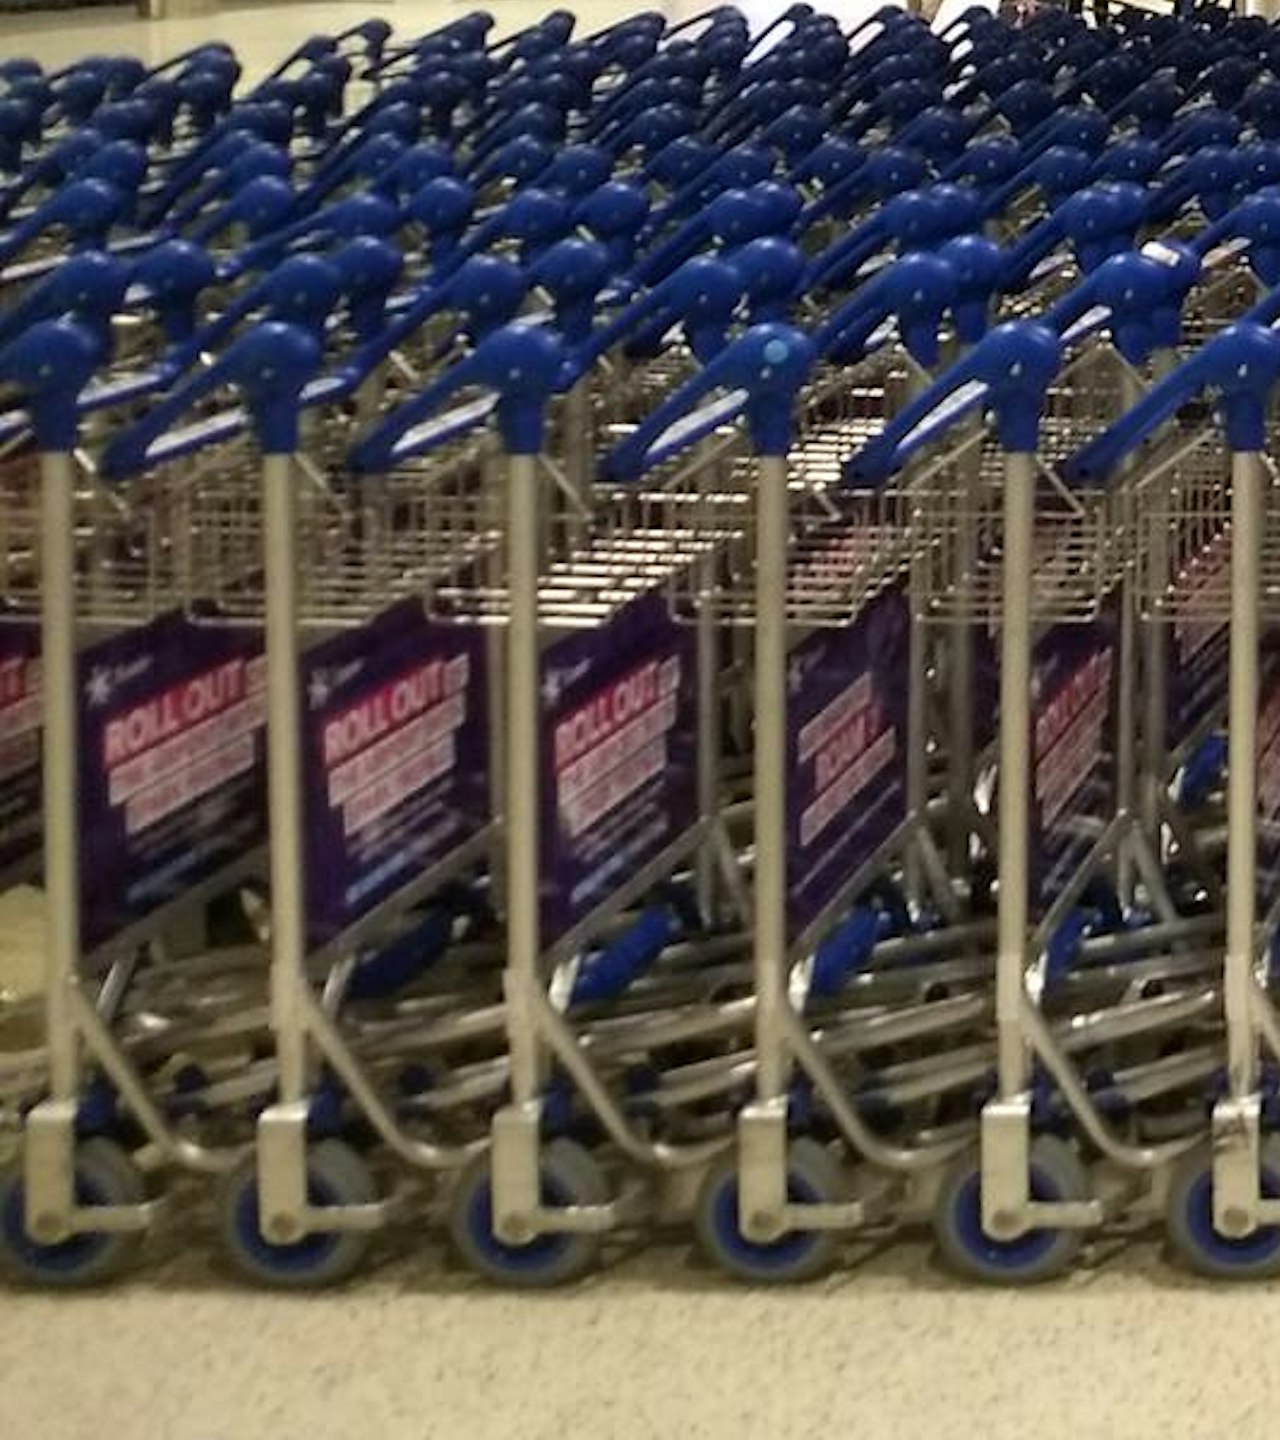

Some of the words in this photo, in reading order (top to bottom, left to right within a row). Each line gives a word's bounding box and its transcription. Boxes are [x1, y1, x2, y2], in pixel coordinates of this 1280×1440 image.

[104, 692, 180, 767] ROLL
[181, 658, 245, 720] OUT
[325, 689, 389, 766] ROLL
[389, 659, 444, 724] OUT
